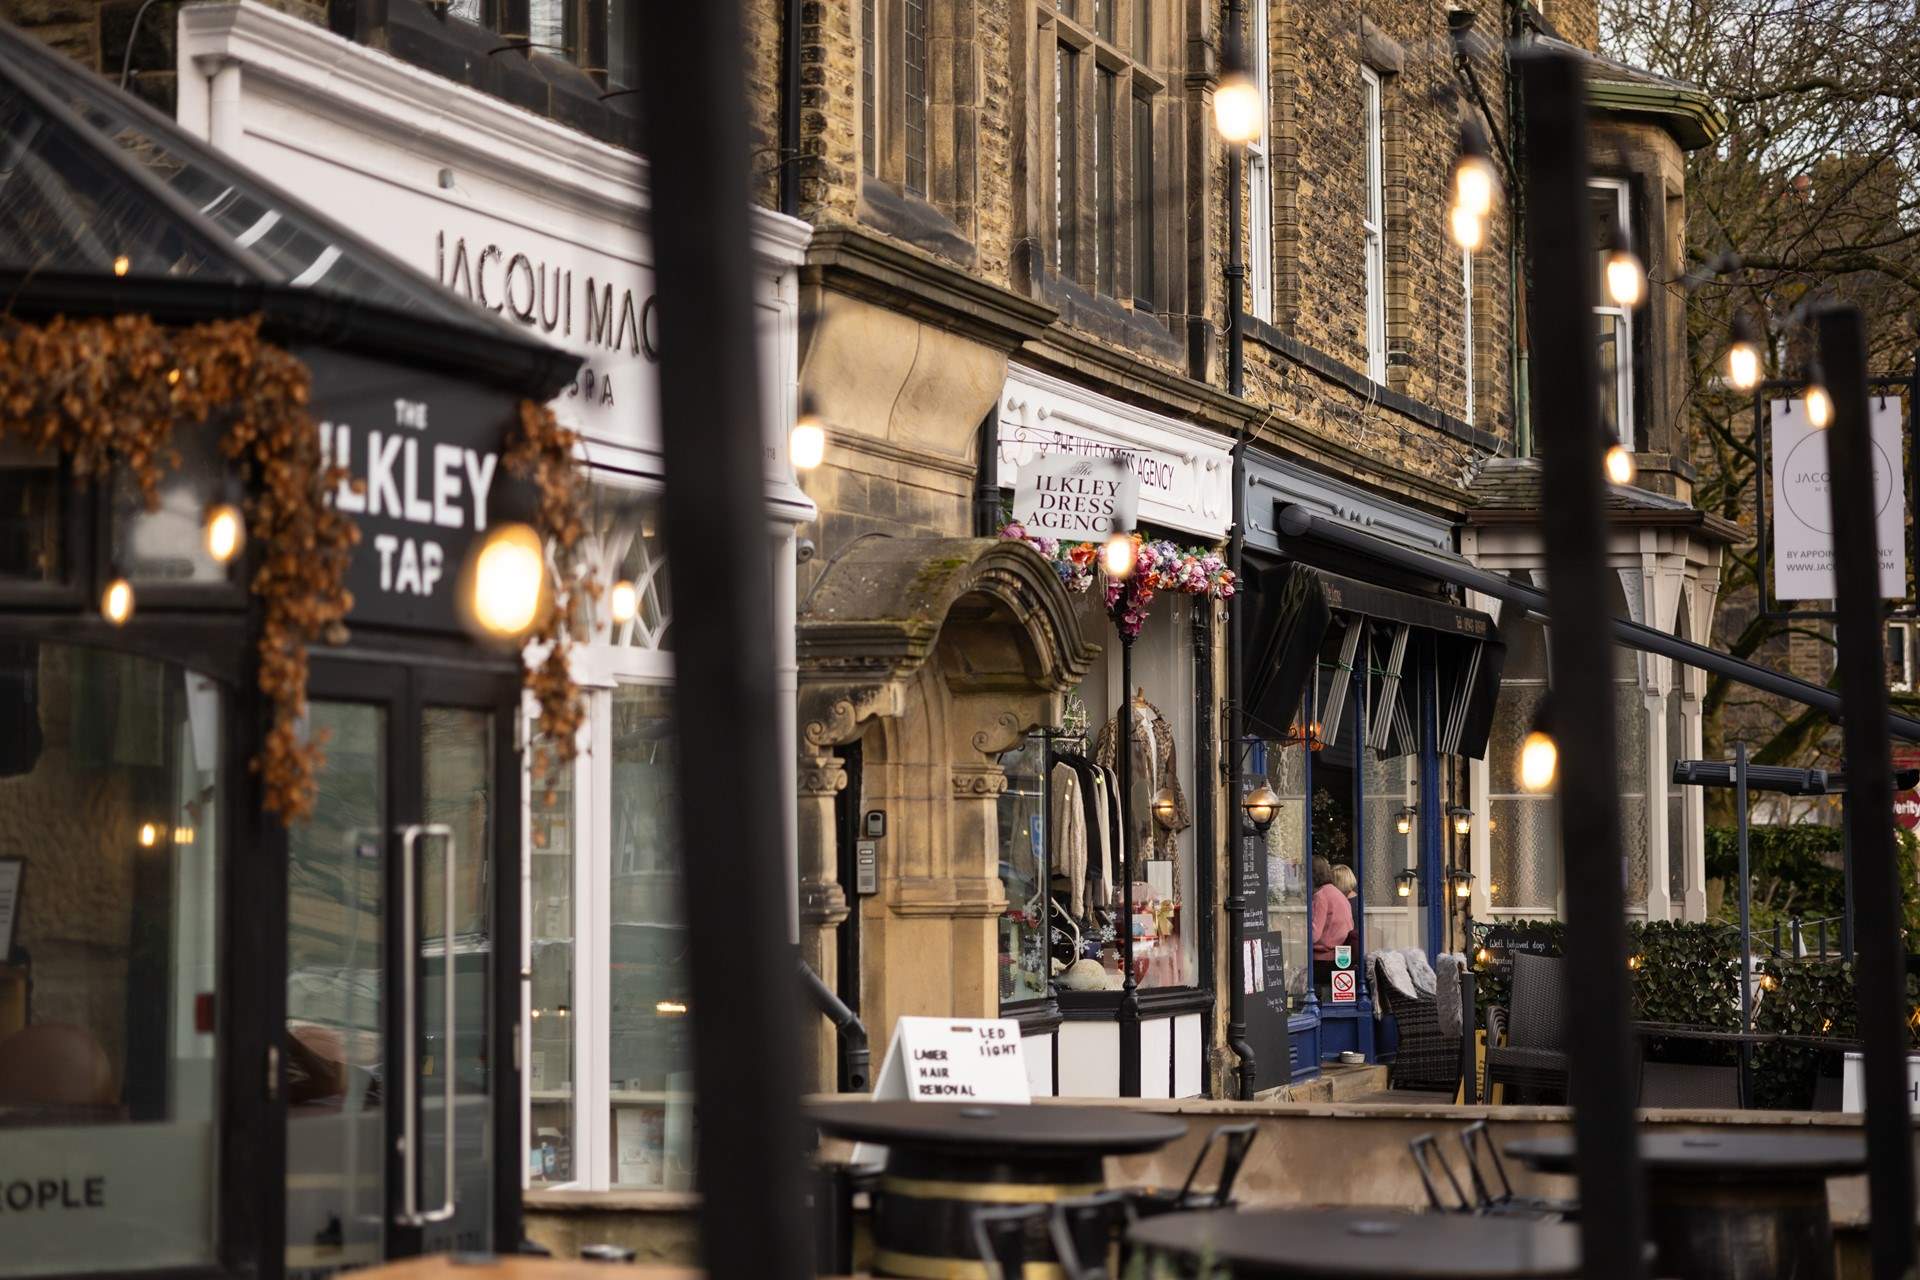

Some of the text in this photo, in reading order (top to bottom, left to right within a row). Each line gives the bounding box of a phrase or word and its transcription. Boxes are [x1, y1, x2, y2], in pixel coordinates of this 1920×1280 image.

[395, 397, 428, 430] THE
[318, 421, 498, 532] ILKLEY
[1069, 461, 1092, 477] The
[1137, 457, 1175, 492] AGENCY
[1035, 475, 1121, 498] ILKLEY
[1039, 493, 1115, 515] DRESS
[374, 534, 444, 596] TAP
[1786, 551, 1798, 559] BY
[1532, 941, 1546, 952] dogs
[979, 1027, 1005, 1039] LED
[920, 1067, 949, 1078] HAIR
[919, 1084, 976, 1097] REMOVAL
[0, 1175, 106, 1212] OPLE
